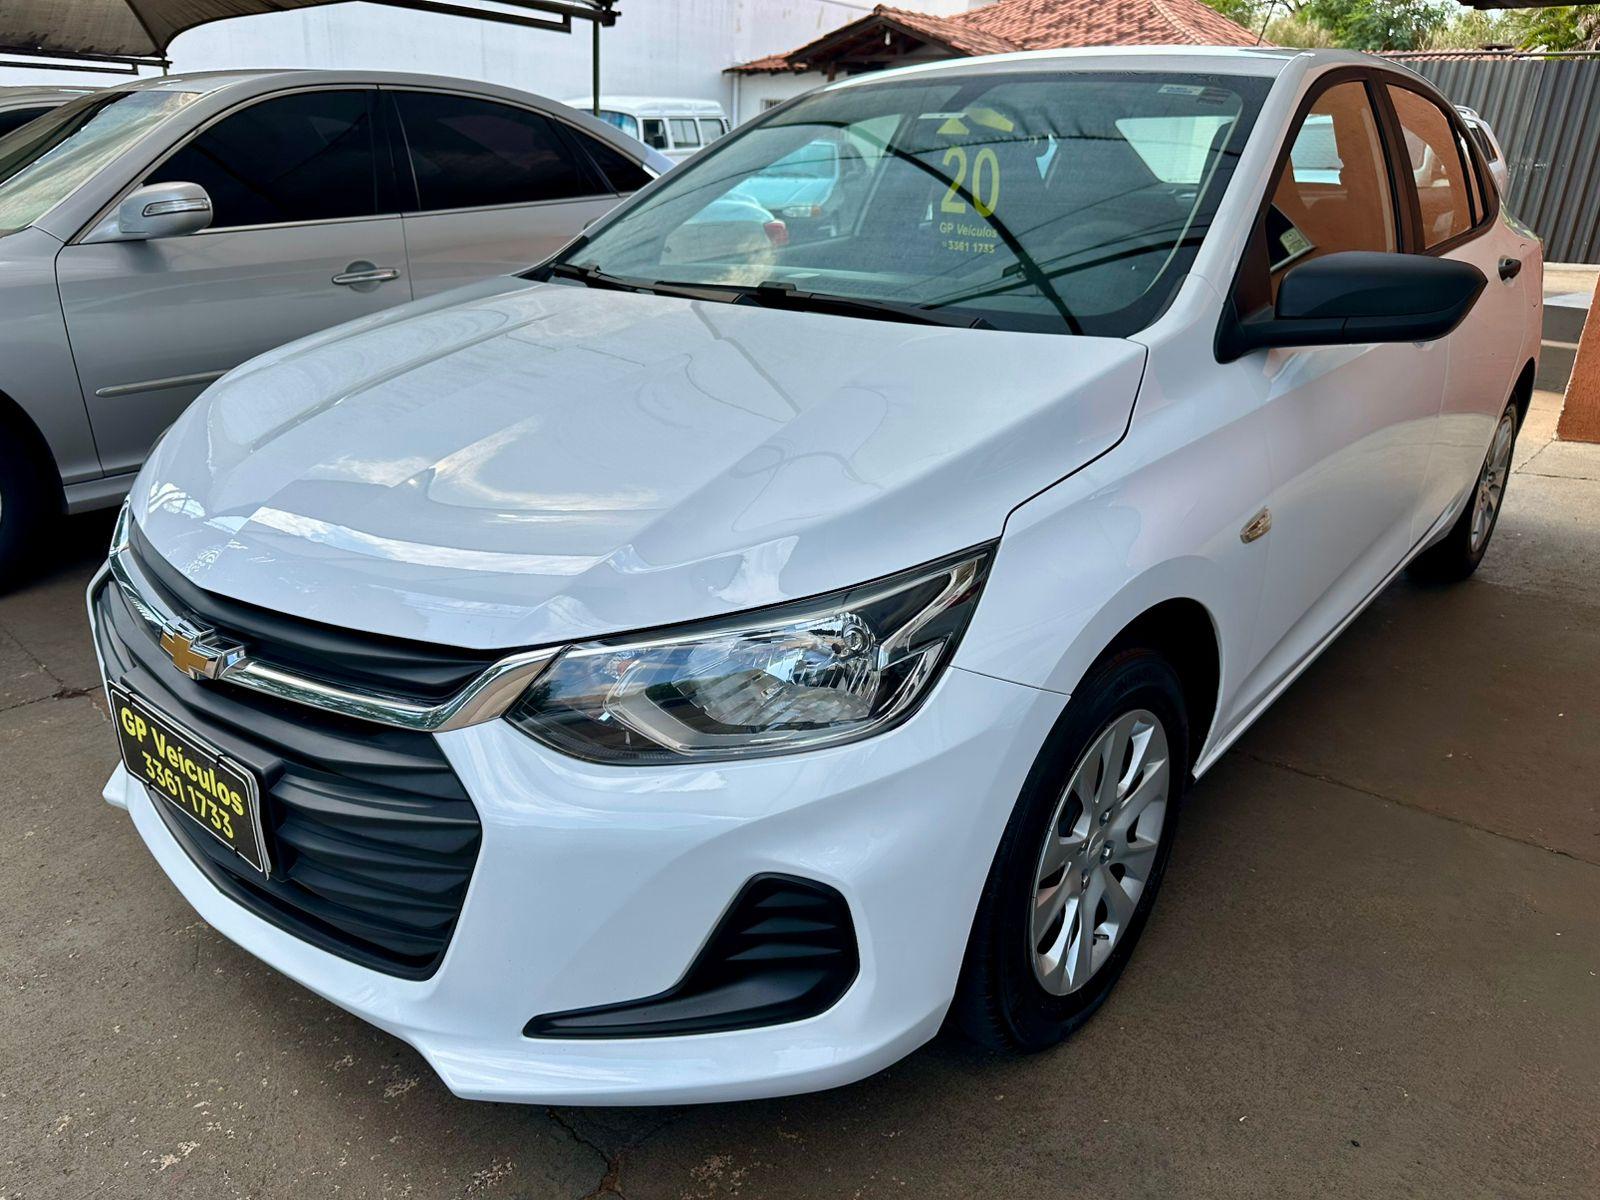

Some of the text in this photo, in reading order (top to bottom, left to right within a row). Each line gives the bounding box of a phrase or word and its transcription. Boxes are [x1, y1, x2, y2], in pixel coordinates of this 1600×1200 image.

[941, 145, 1000, 218] 20
[939, 221, 954, 234] GP
[121, 707, 244, 816] GP Veículos
[142, 751, 234, 839] 3361 1733
